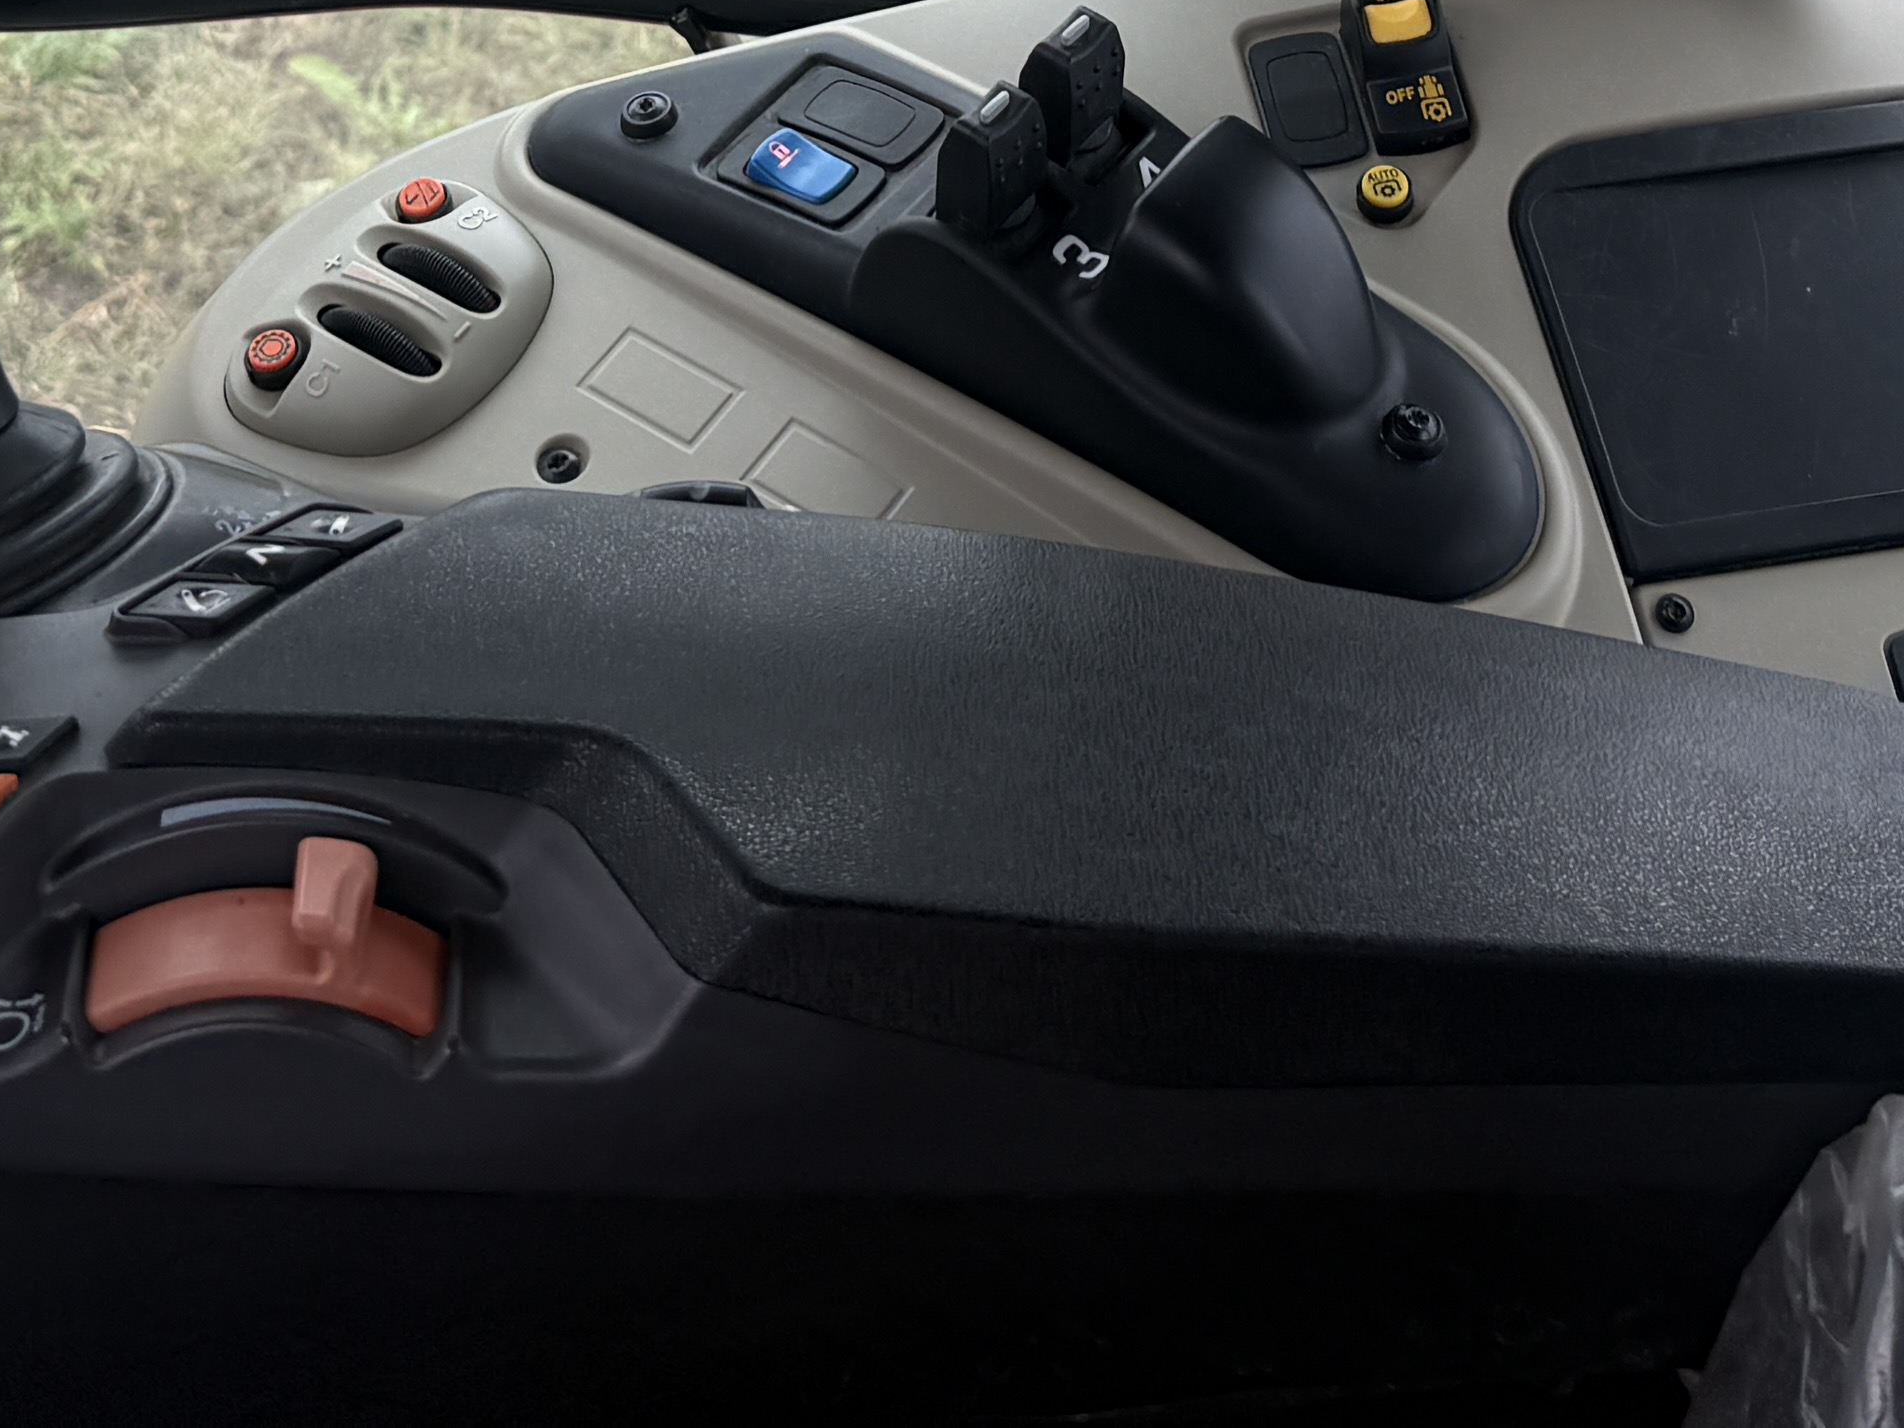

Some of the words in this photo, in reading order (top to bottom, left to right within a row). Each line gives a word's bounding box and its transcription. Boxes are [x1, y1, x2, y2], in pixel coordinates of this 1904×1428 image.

[1385, 85, 1415, 105] OFF
[1367, 168, 1400, 183] AUTO
[457, 205, 498, 231] C2
[1052, 233, 1110, 280] 3
[304, 358, 340, 398] C1
